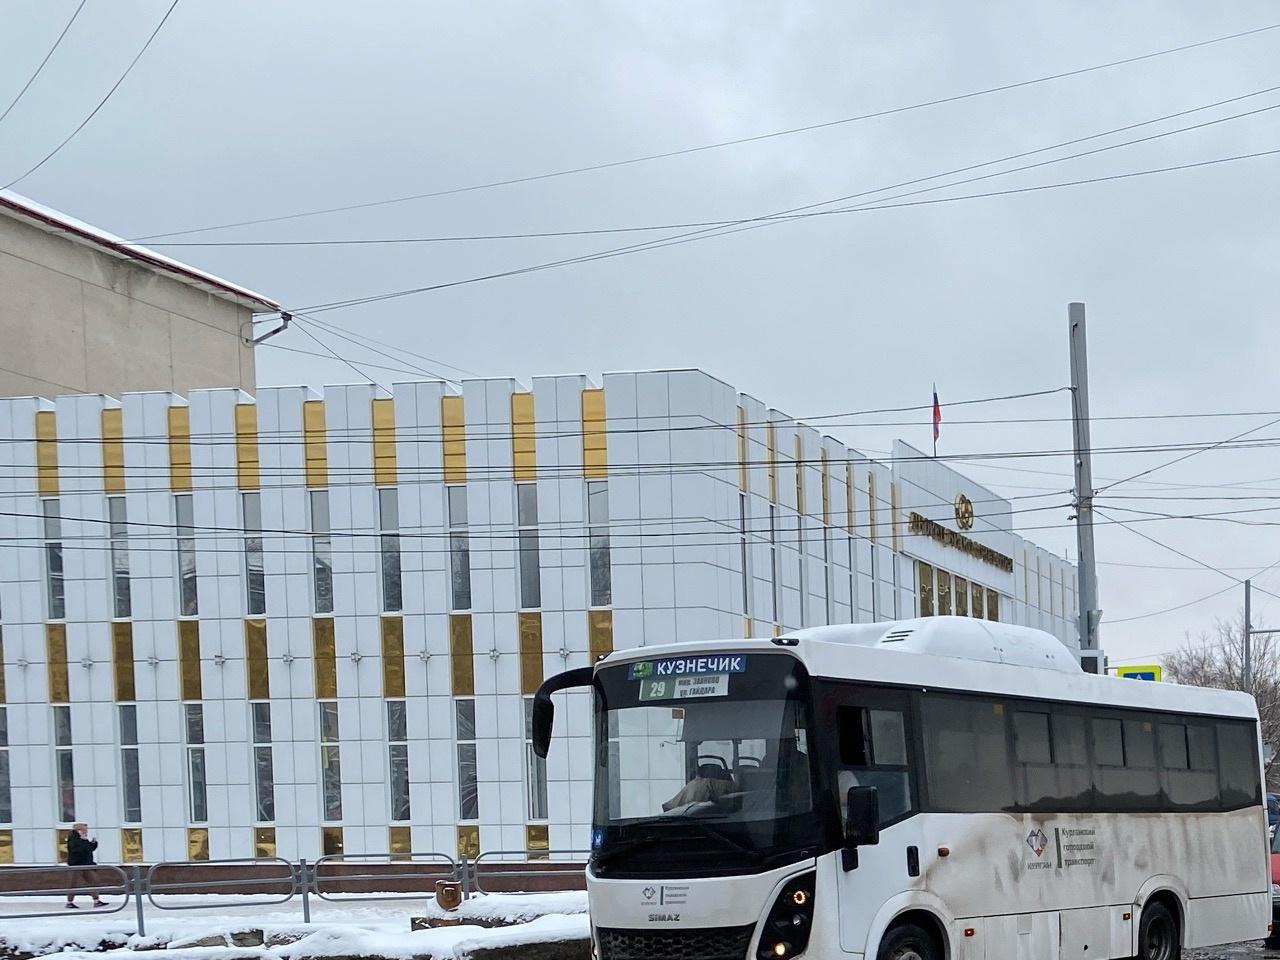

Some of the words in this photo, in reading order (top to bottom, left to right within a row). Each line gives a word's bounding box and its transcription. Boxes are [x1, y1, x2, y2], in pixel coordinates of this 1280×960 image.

[657, 657, 741, 676] КУЗНЕЧИК
[650, 681, 666, 697] 29
[689, 686, 716, 696] ГАЙДАРА
[1027, 861, 1052, 870] КУРГАН
[1064, 858, 1096, 867] транспорт
